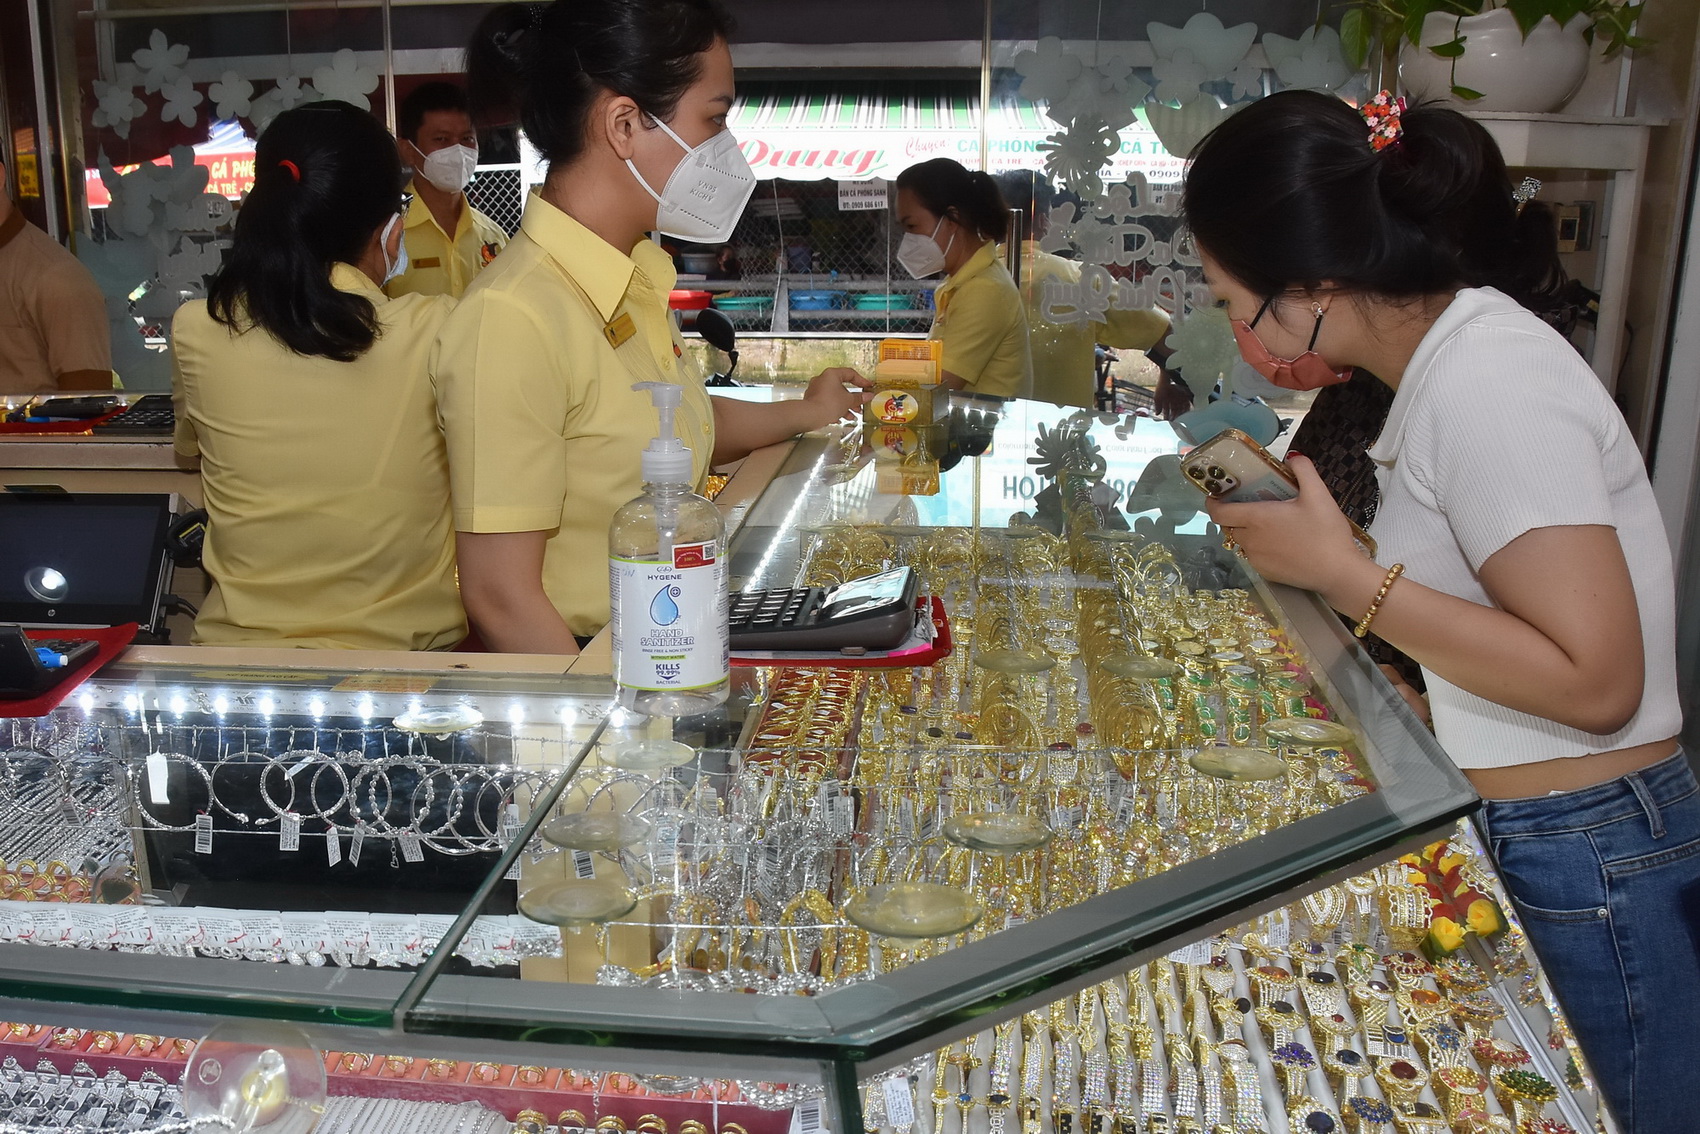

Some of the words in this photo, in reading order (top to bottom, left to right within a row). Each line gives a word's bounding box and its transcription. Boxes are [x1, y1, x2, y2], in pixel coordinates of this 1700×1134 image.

[212, 158, 228, 179] CÁ
[221, 181, 238, 194] TRÊ
[650, 629, 683, 638] HAND
[640, 636, 694, 646] SANITIZER
